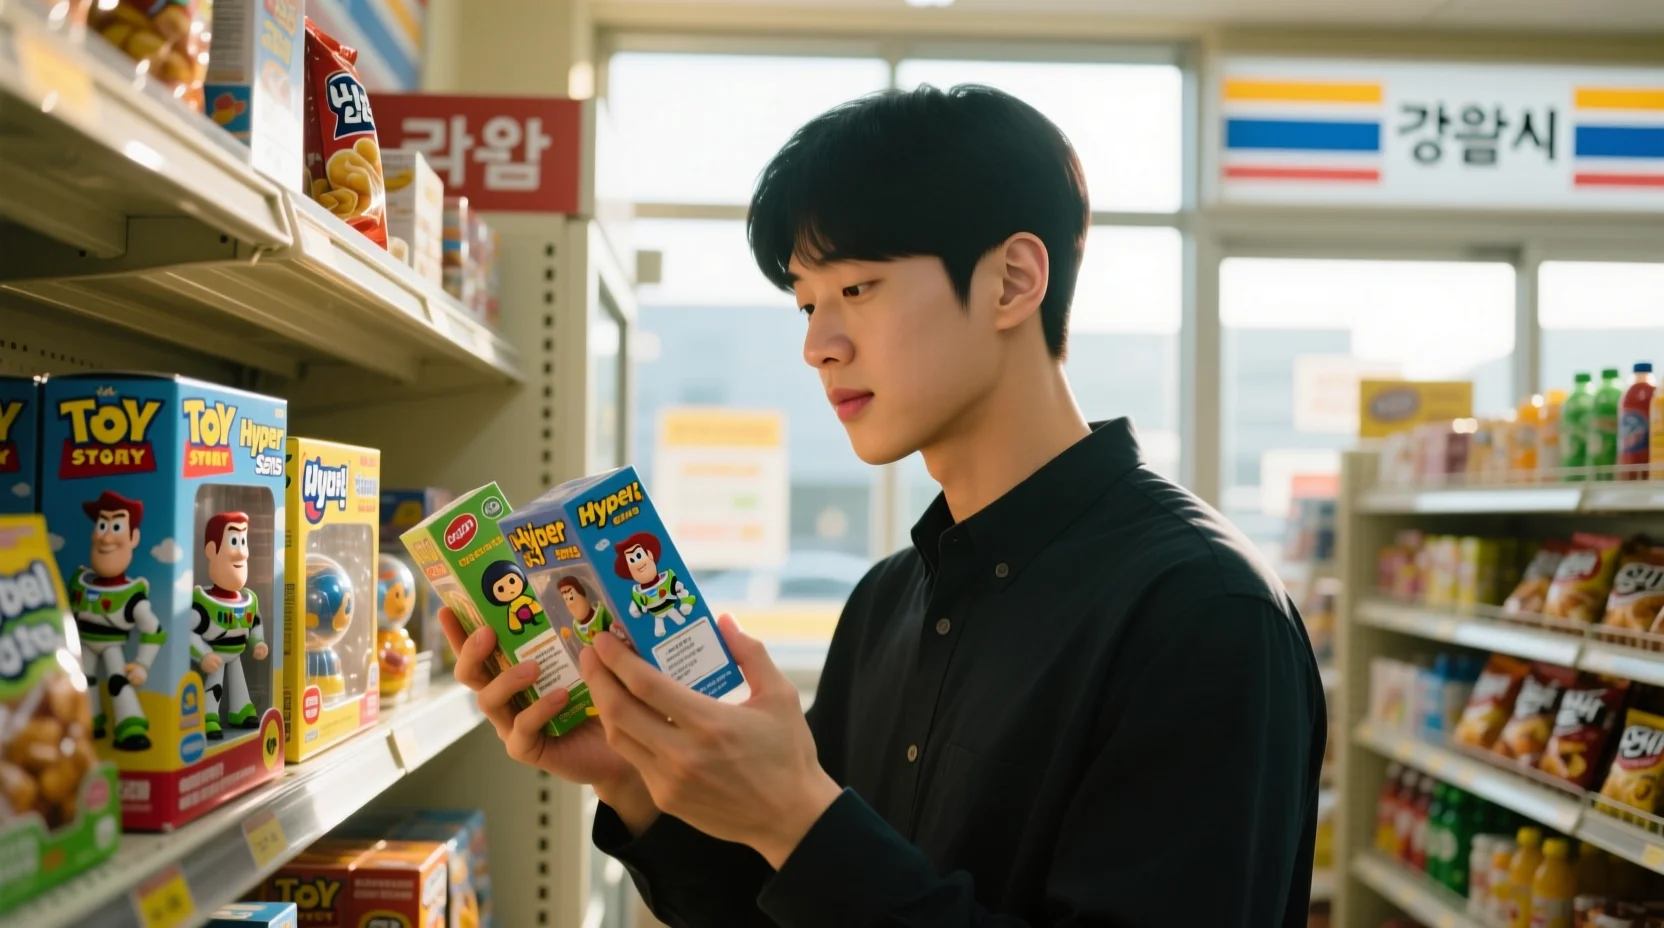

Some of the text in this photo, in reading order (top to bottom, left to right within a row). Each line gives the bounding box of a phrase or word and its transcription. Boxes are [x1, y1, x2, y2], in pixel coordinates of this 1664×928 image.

[59, 397, 162, 445] TOY
[182, 398, 238, 447] TOY
[239, 417, 285, 458] Hyper
